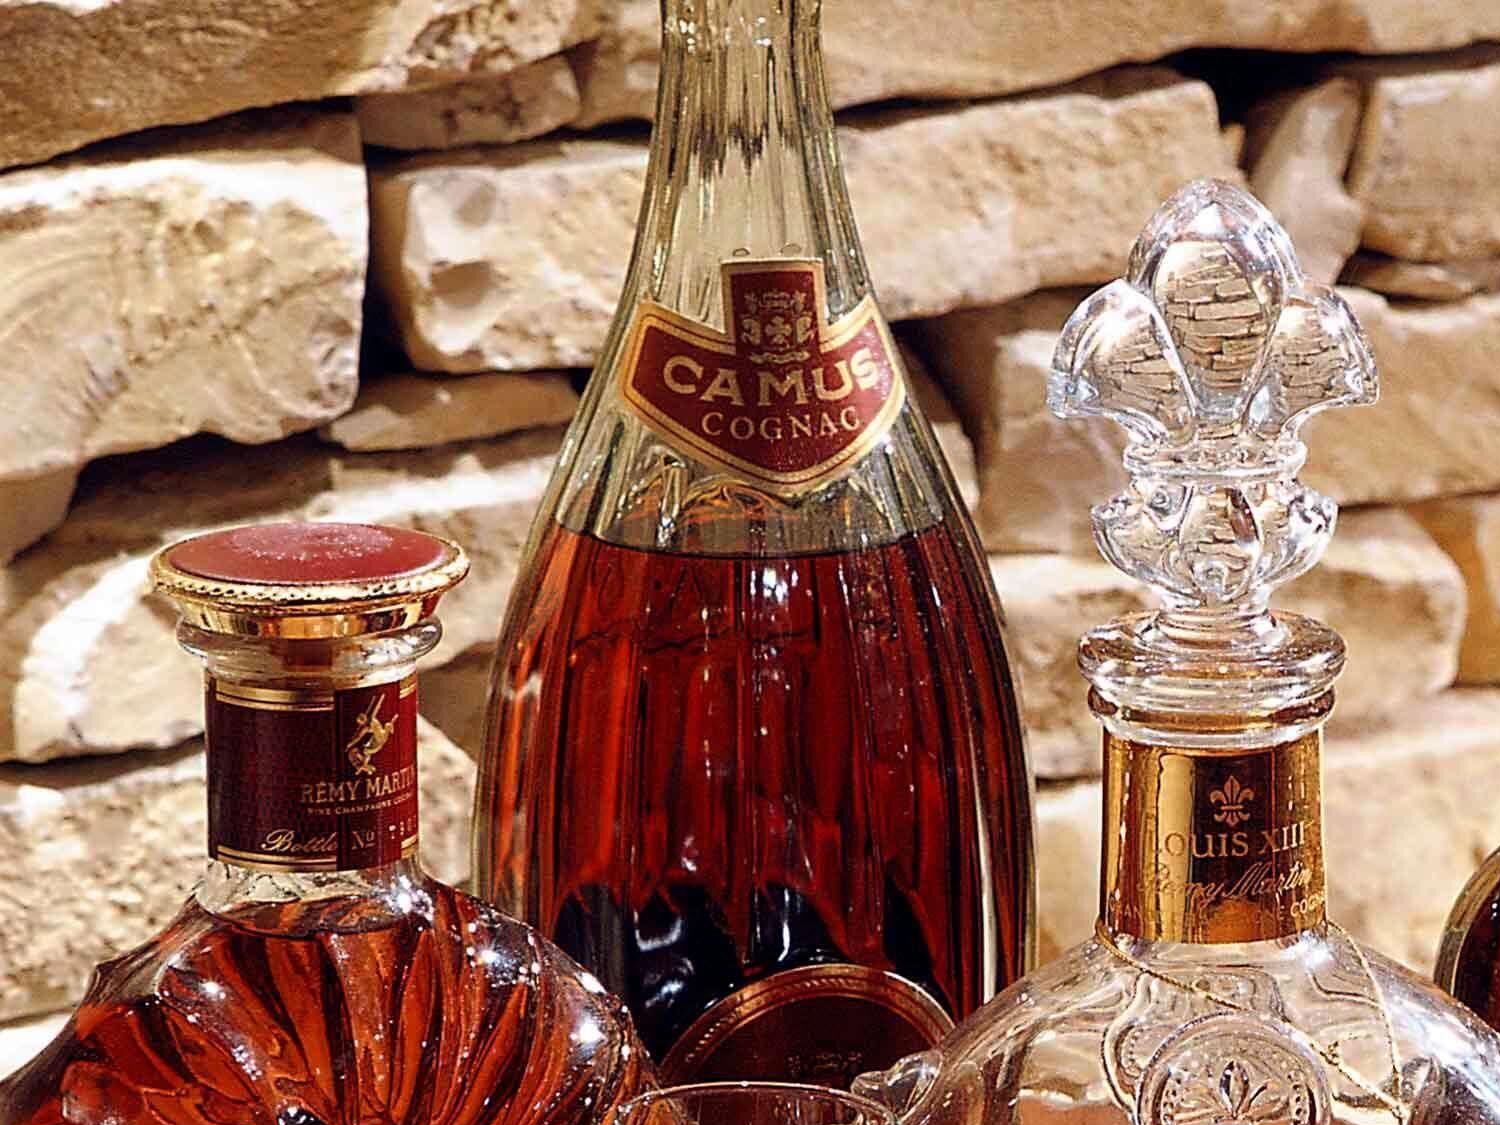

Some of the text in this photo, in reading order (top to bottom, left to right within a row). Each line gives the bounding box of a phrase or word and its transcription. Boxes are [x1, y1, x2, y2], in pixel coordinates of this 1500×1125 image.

[662, 347, 880, 407] CAMUS
[701, 405, 861, 441] COGNAC
[1258, 820, 1310, 854] XIII
